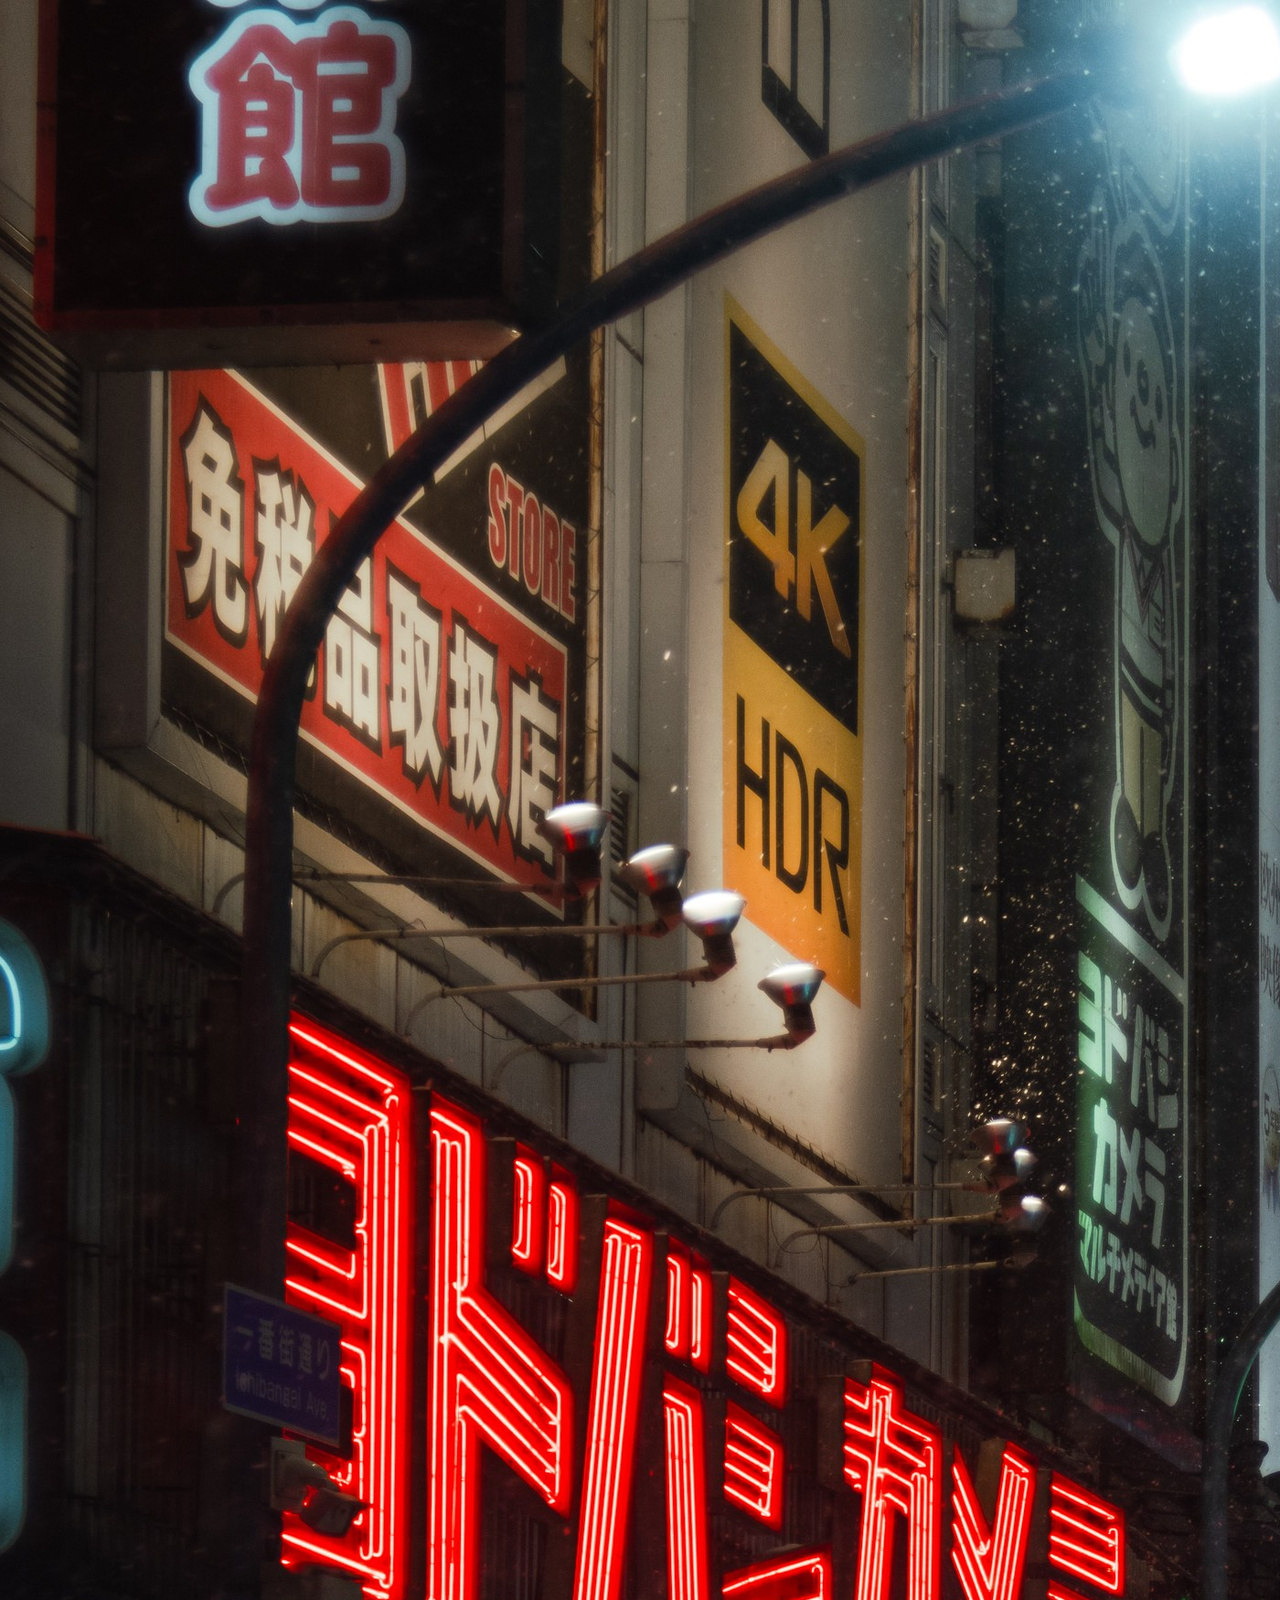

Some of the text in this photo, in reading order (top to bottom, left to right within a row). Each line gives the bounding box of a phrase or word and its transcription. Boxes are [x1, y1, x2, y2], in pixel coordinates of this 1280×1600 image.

[188, 0, 410, 225] 館
[487, 462, 577, 624] STORE
[737, 438, 851, 659] 4K
[735, 692, 851, 938] HDR
[1077, 950, 1178, 1130] ヨドバシ
[1092, 1095, 1168, 1249] カメラ
[236, 1318, 330, 1380] 一番街通り
[236, 1366, 301, 1411] Ichibangai
